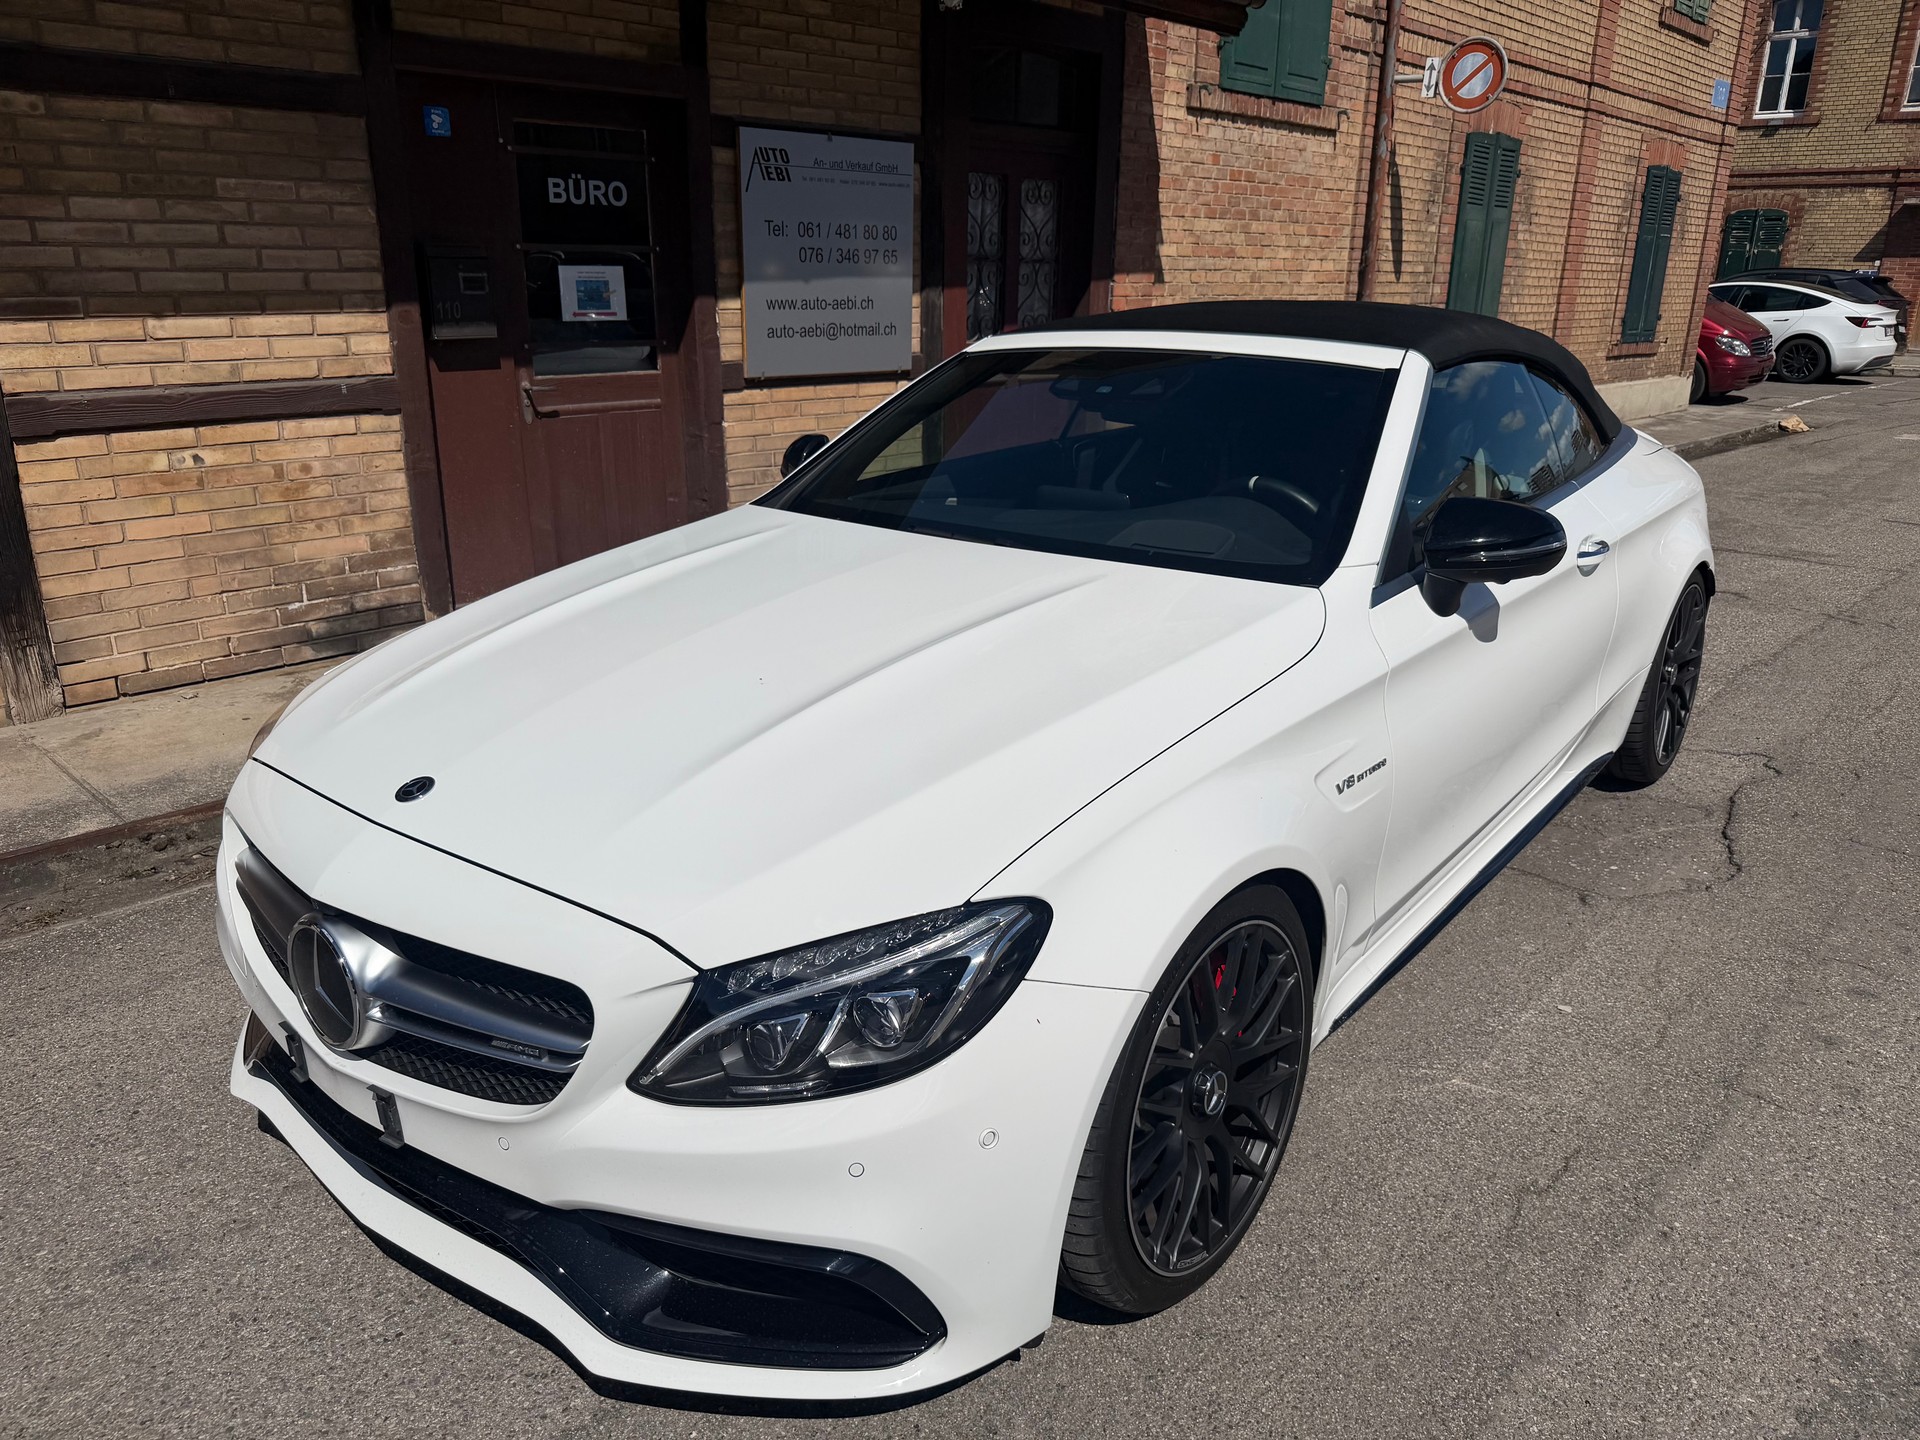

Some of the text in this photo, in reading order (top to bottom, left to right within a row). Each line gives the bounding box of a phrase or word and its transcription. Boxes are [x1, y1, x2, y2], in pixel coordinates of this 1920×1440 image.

[813, 157, 898, 173] An- und Verkauf GmbH
[547, 173, 628, 207] BÜRO
[764, 219, 898, 241] Tel: 061 / 481 80 80
[798, 246, 898, 265] 076 / 346 97 65
[436, 301, 462, 319] 110
[766, 295, 874, 311] www.auto-aebi.ch
[766, 322, 897, 341] auto-aebi@hotmail.ch
[1334, 774, 1356, 796] V8
